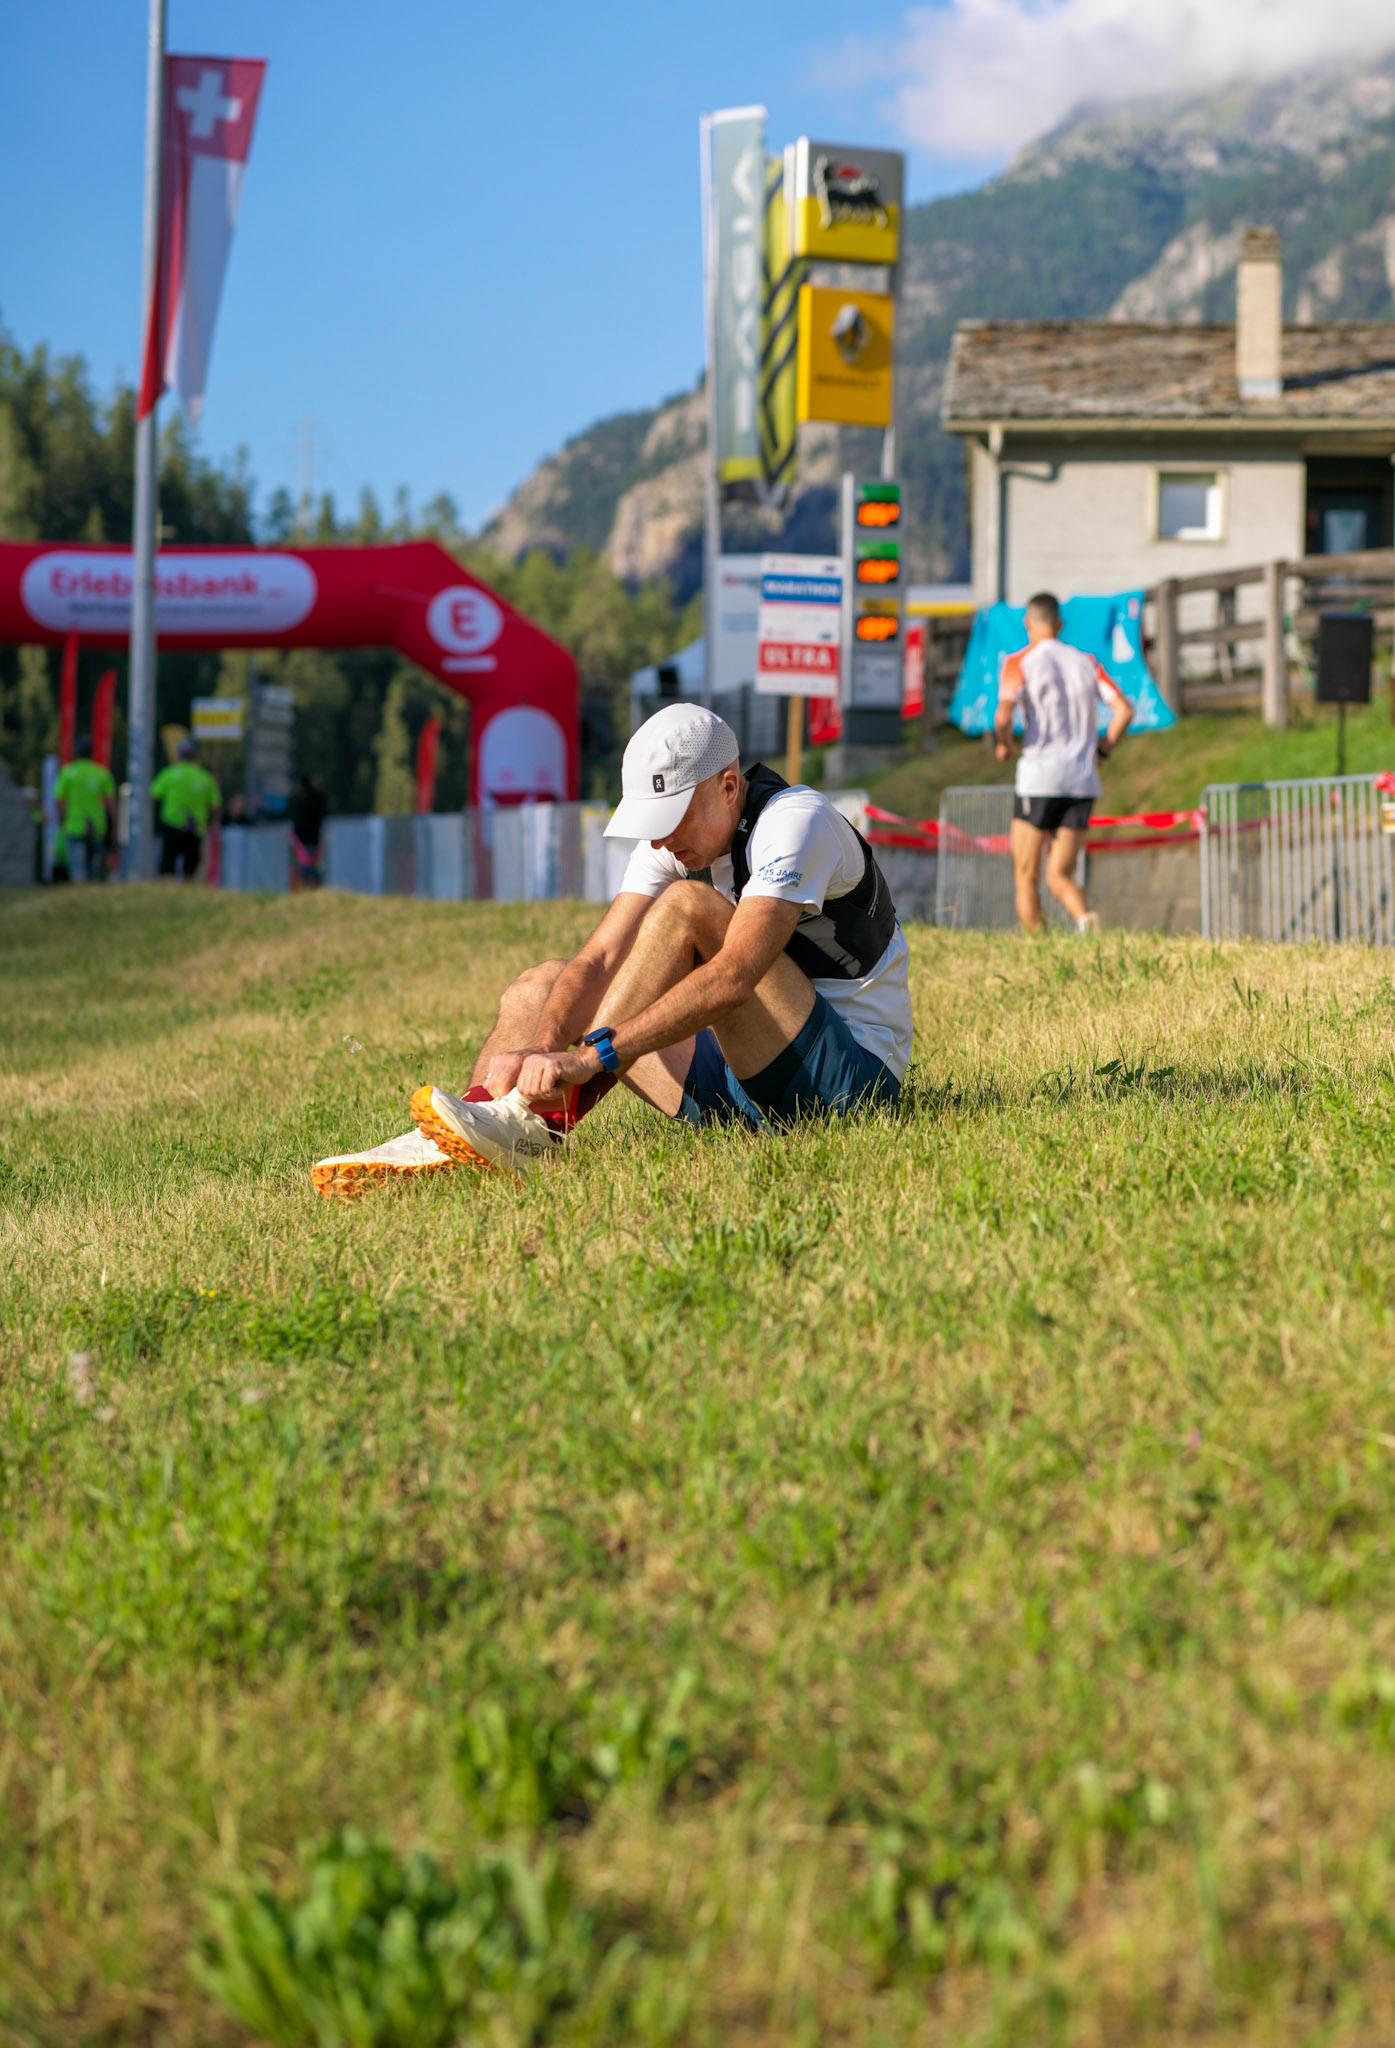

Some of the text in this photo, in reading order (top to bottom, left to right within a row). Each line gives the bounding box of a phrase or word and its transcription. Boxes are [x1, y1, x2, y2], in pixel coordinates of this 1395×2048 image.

[452, 601, 479, 640] E
[764, 646, 832, 668] ULTRA
[776, 869, 804, 880] JAHRE
